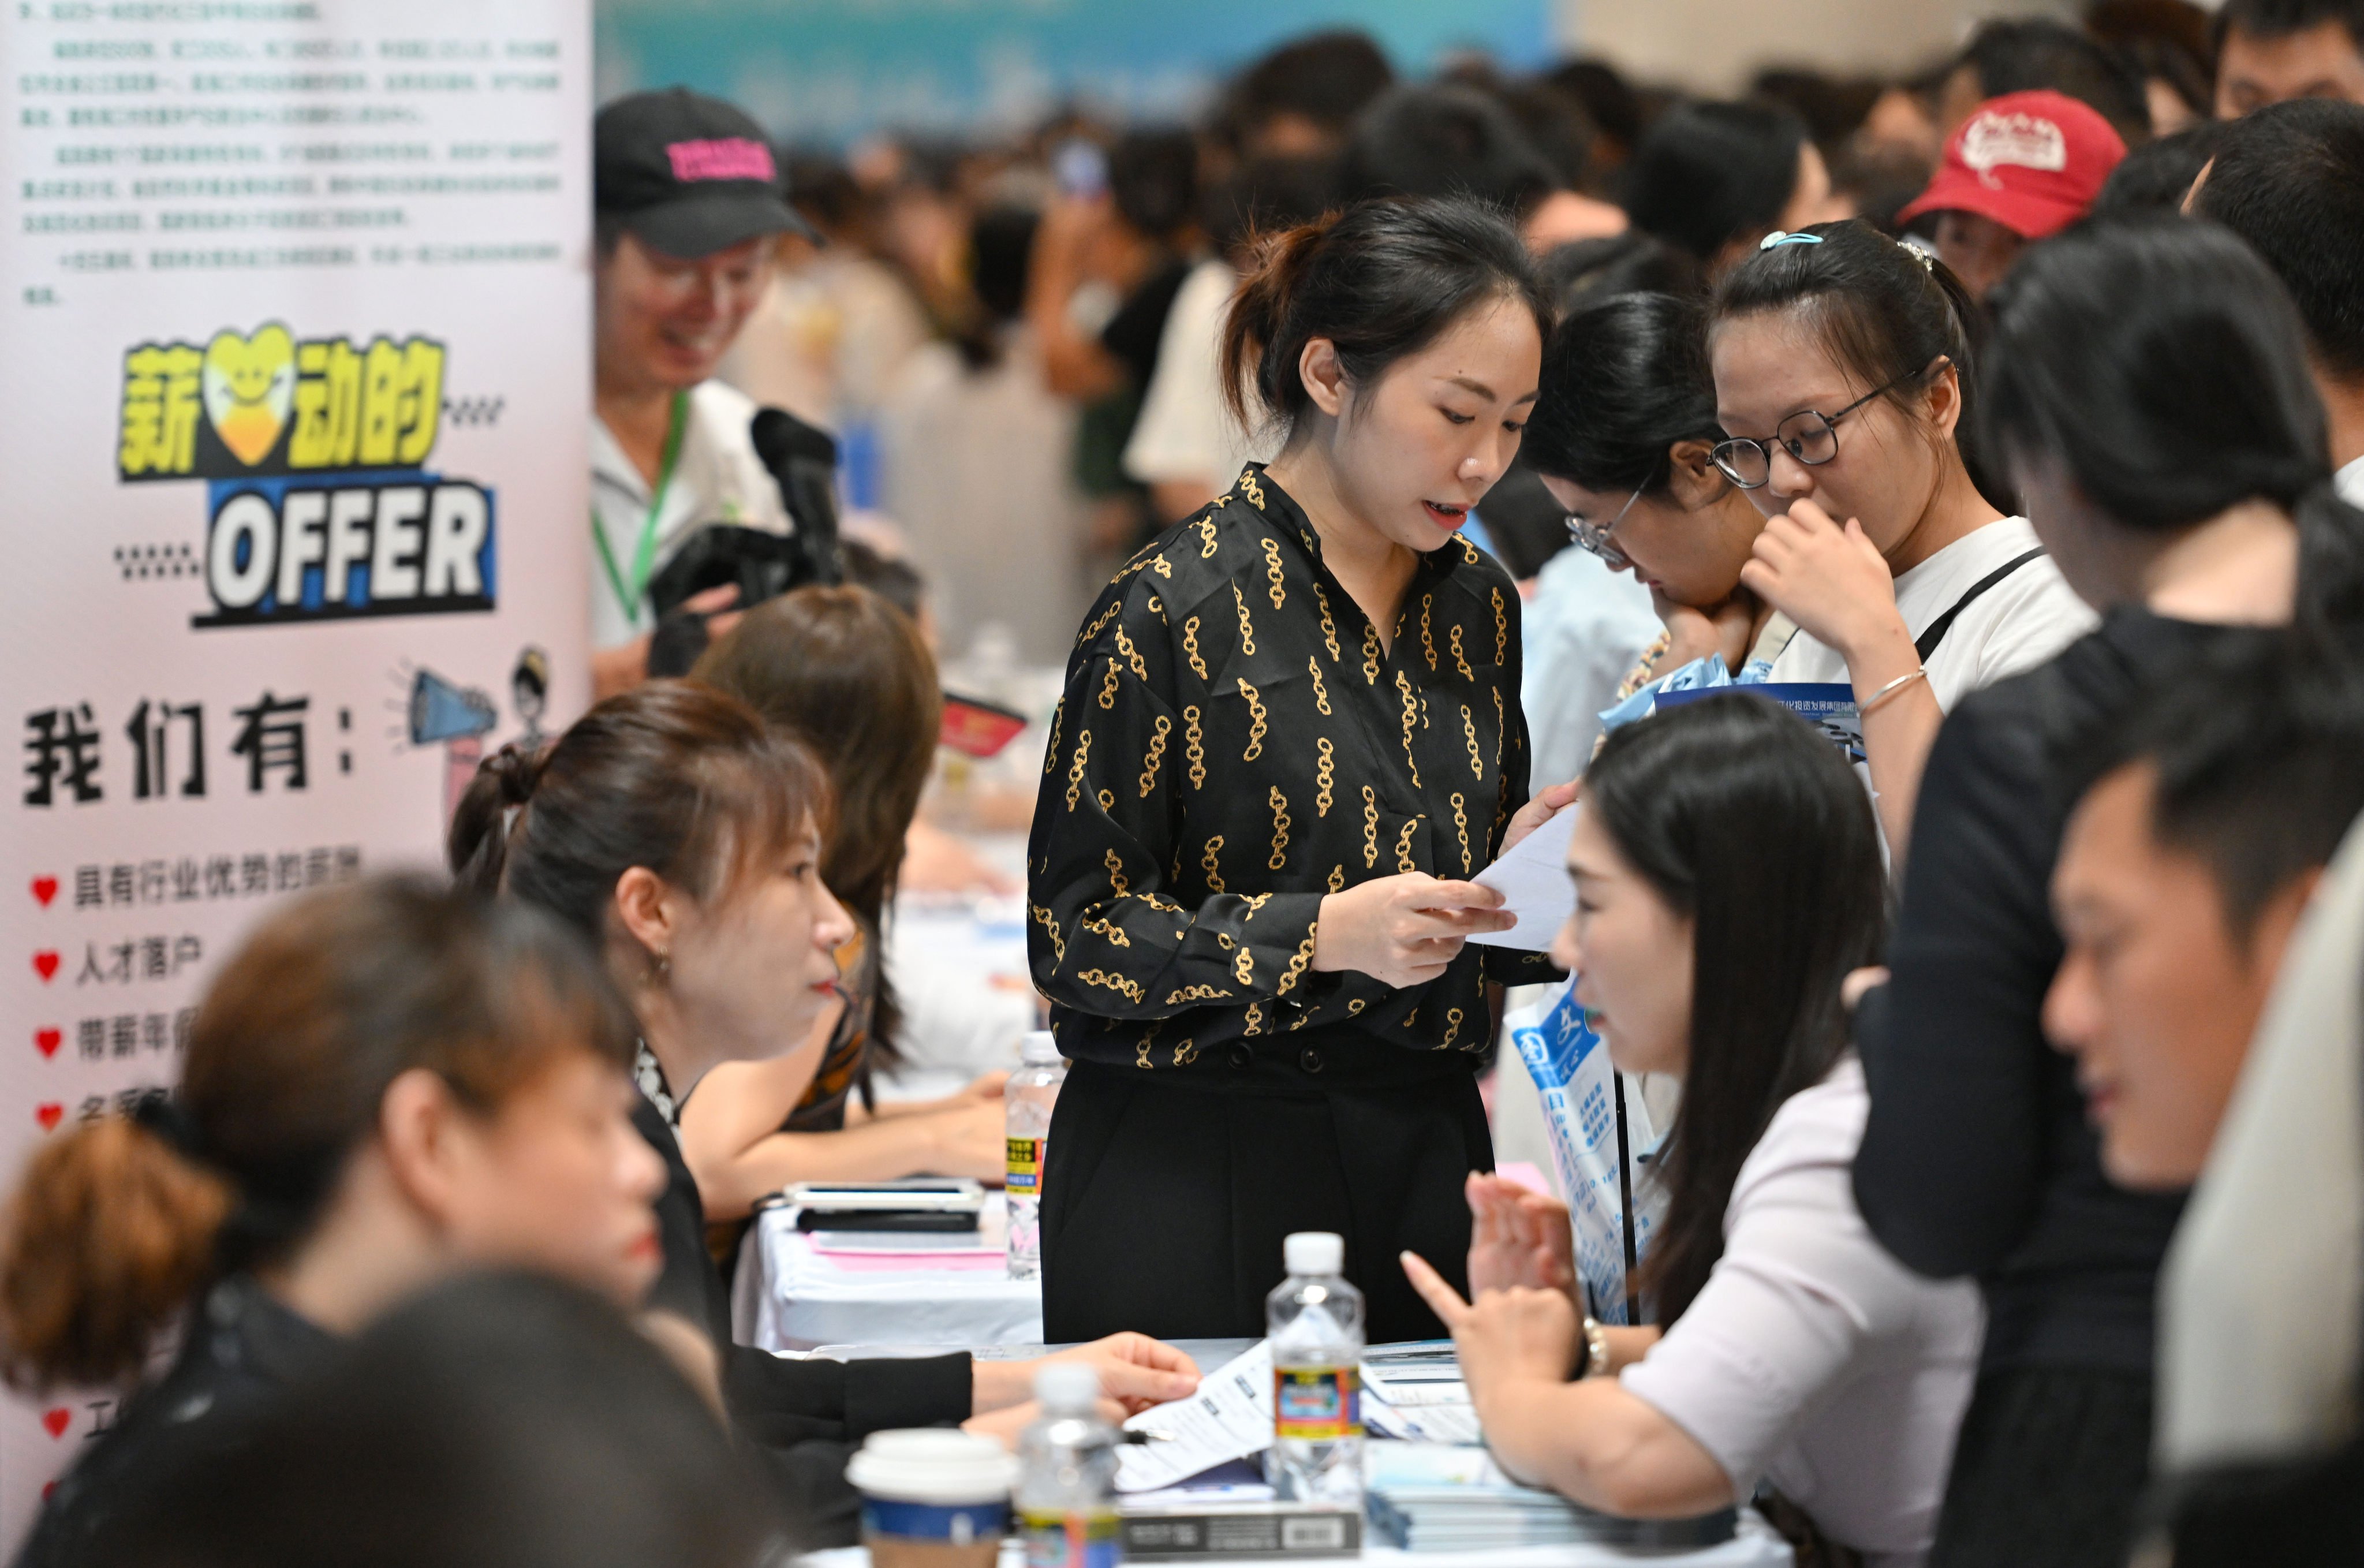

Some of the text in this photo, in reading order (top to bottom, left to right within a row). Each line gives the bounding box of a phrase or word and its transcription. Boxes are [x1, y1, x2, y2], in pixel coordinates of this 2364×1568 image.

[209, 484, 488, 608] OFFER
[77, 936, 201, 984] 人才落户
